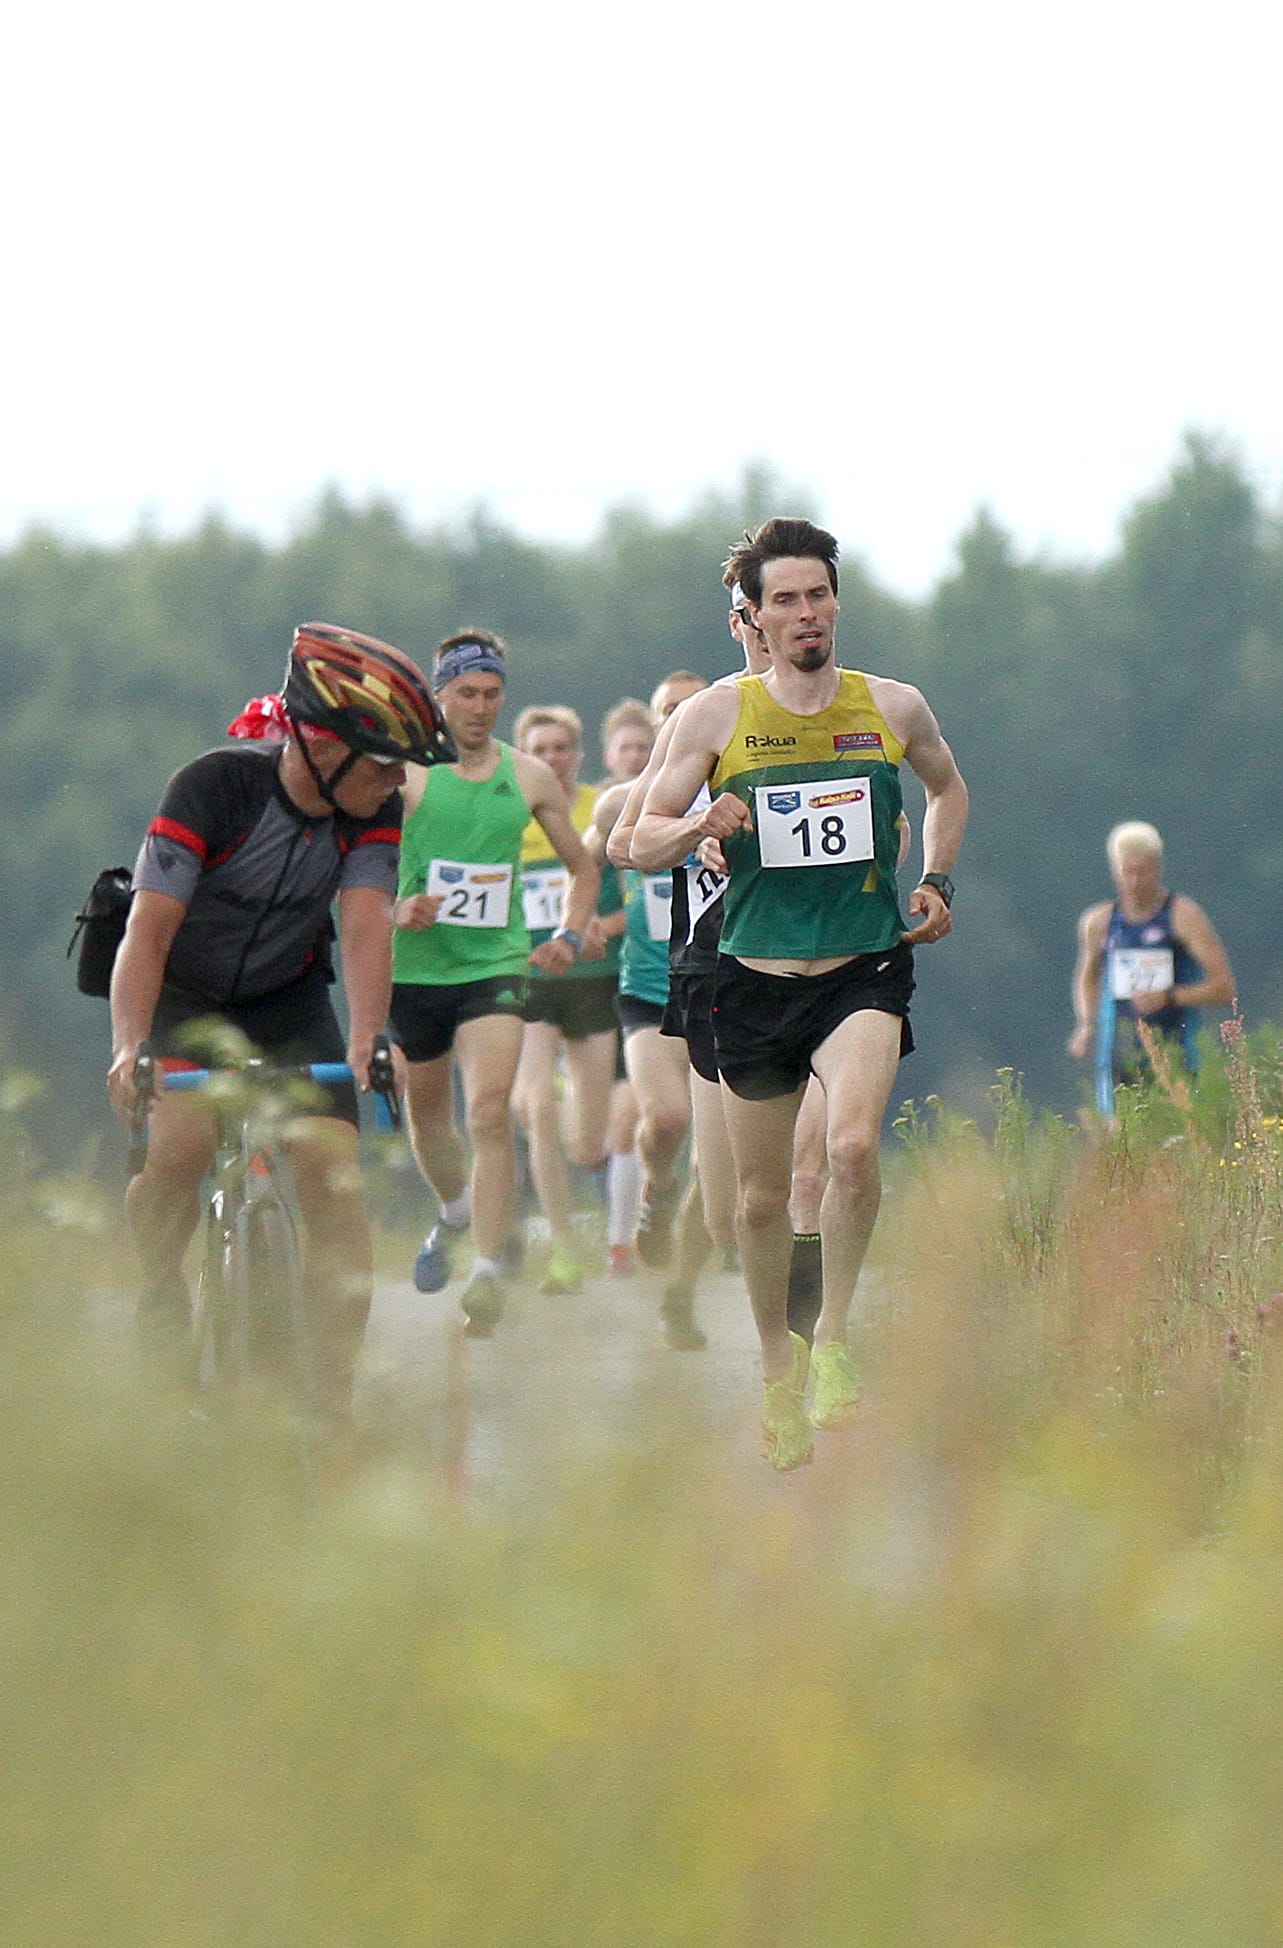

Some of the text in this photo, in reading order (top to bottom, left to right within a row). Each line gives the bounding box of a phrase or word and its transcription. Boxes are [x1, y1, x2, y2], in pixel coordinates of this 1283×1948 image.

[746, 735, 796, 748] Rokua
[792, 815, 847, 857] 18
[448, 889, 488, 919] 21
